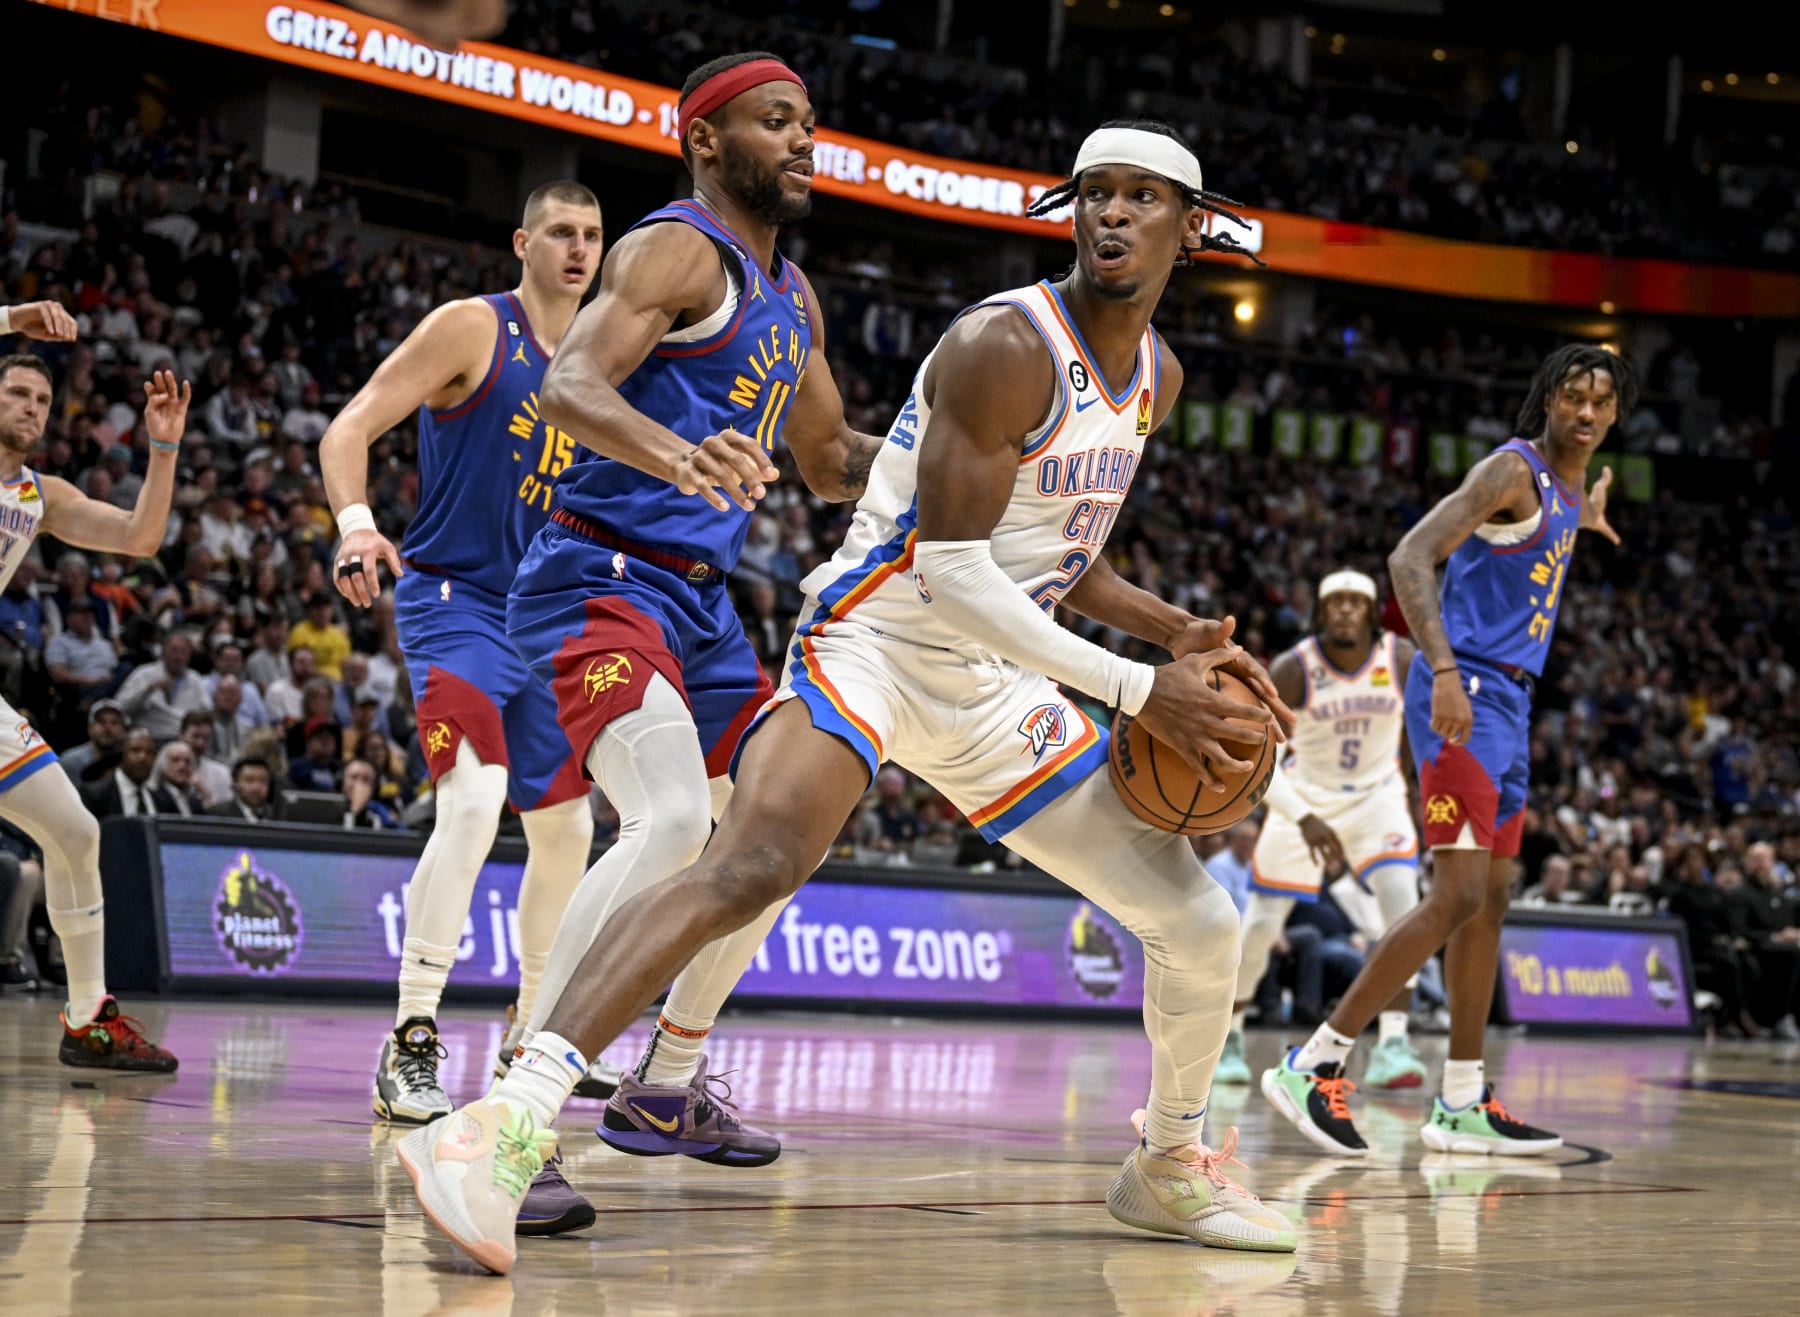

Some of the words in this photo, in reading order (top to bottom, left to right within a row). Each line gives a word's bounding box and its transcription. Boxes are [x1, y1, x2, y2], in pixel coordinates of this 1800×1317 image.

[265, 4, 358, 60] GRIZ:
[358, 28, 516, 99] ANOTHER
[518, 66, 635, 126] WORLD
[884, 158, 1024, 216] OCTOBER
[728, 323, 783, 410] MILE
[1071, 364, 1086, 391] 6
[756, 379, 791, 452] 11
[537, 424, 576, 477] 15
[1037, 447, 1140, 497] OKLAHO
[1028, 547, 1093, 613] 2
[1339, 738, 1362, 770] 5
[780, 903, 883, 977] free
